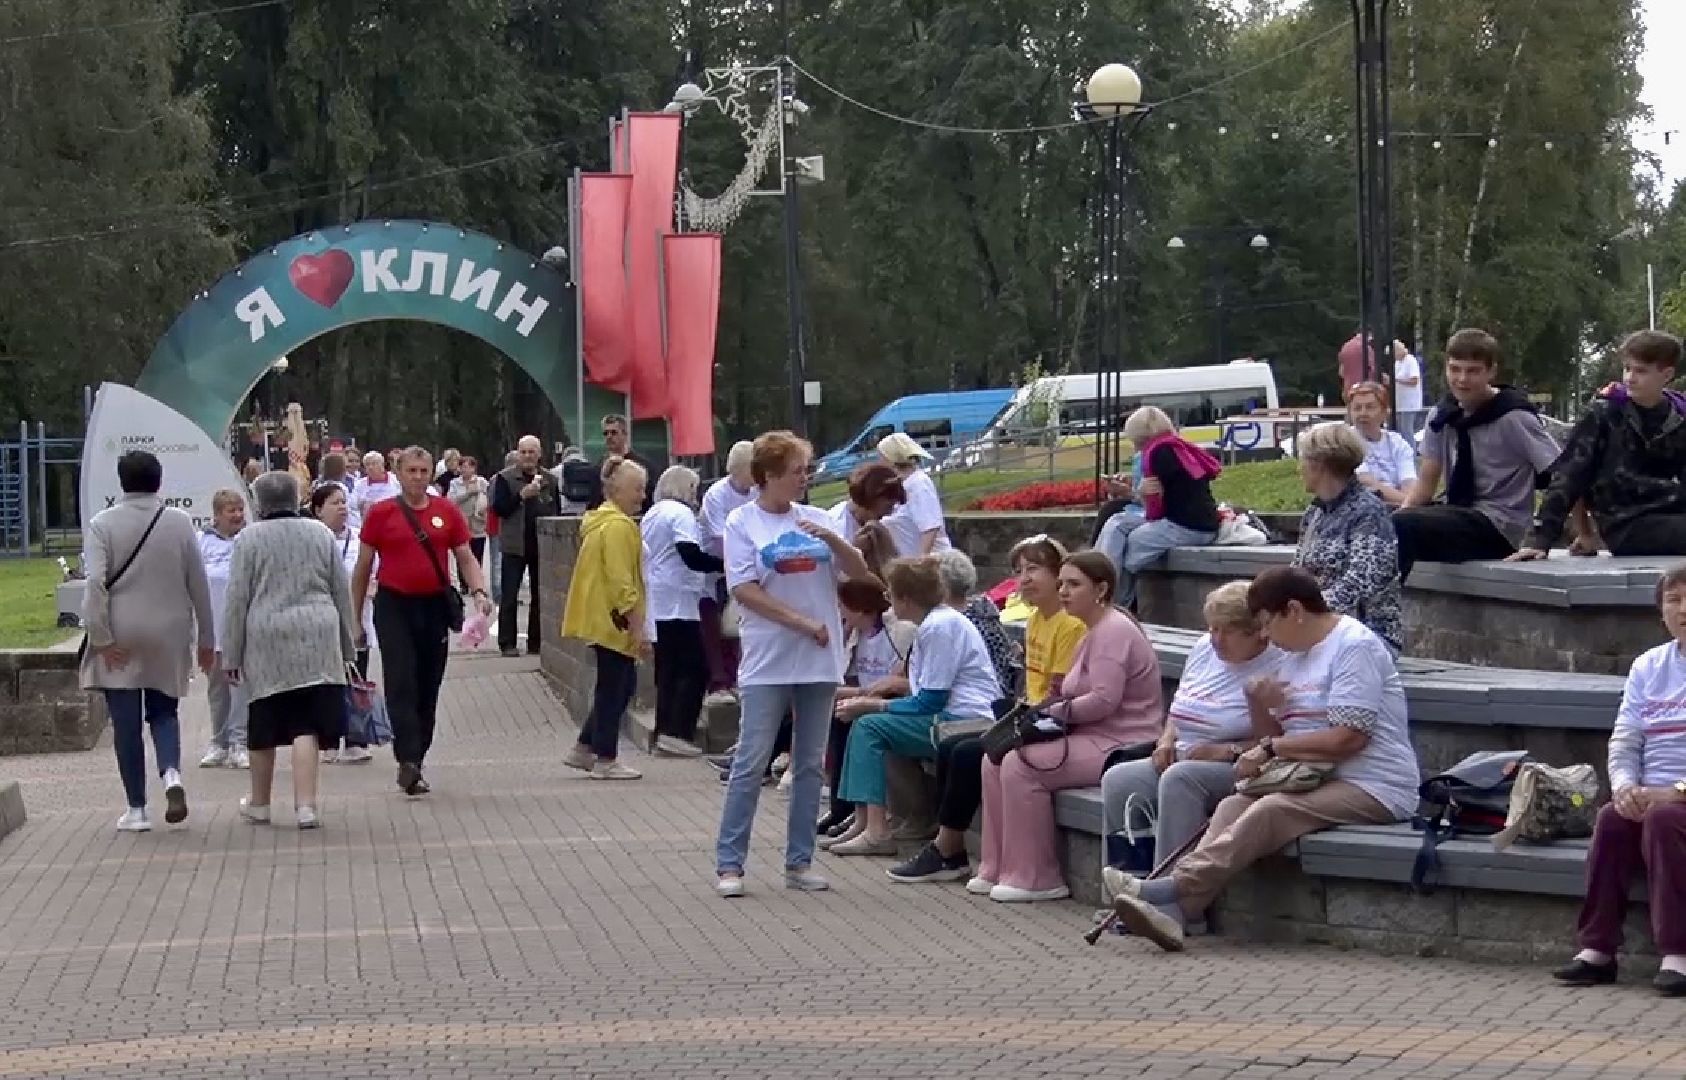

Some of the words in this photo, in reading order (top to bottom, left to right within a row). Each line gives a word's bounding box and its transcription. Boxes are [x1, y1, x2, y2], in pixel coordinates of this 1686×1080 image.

[235, 286, 286, 342] Я
[360, 248, 549, 337] КЛИН
[120, 435, 155, 445] ПАРКИ
